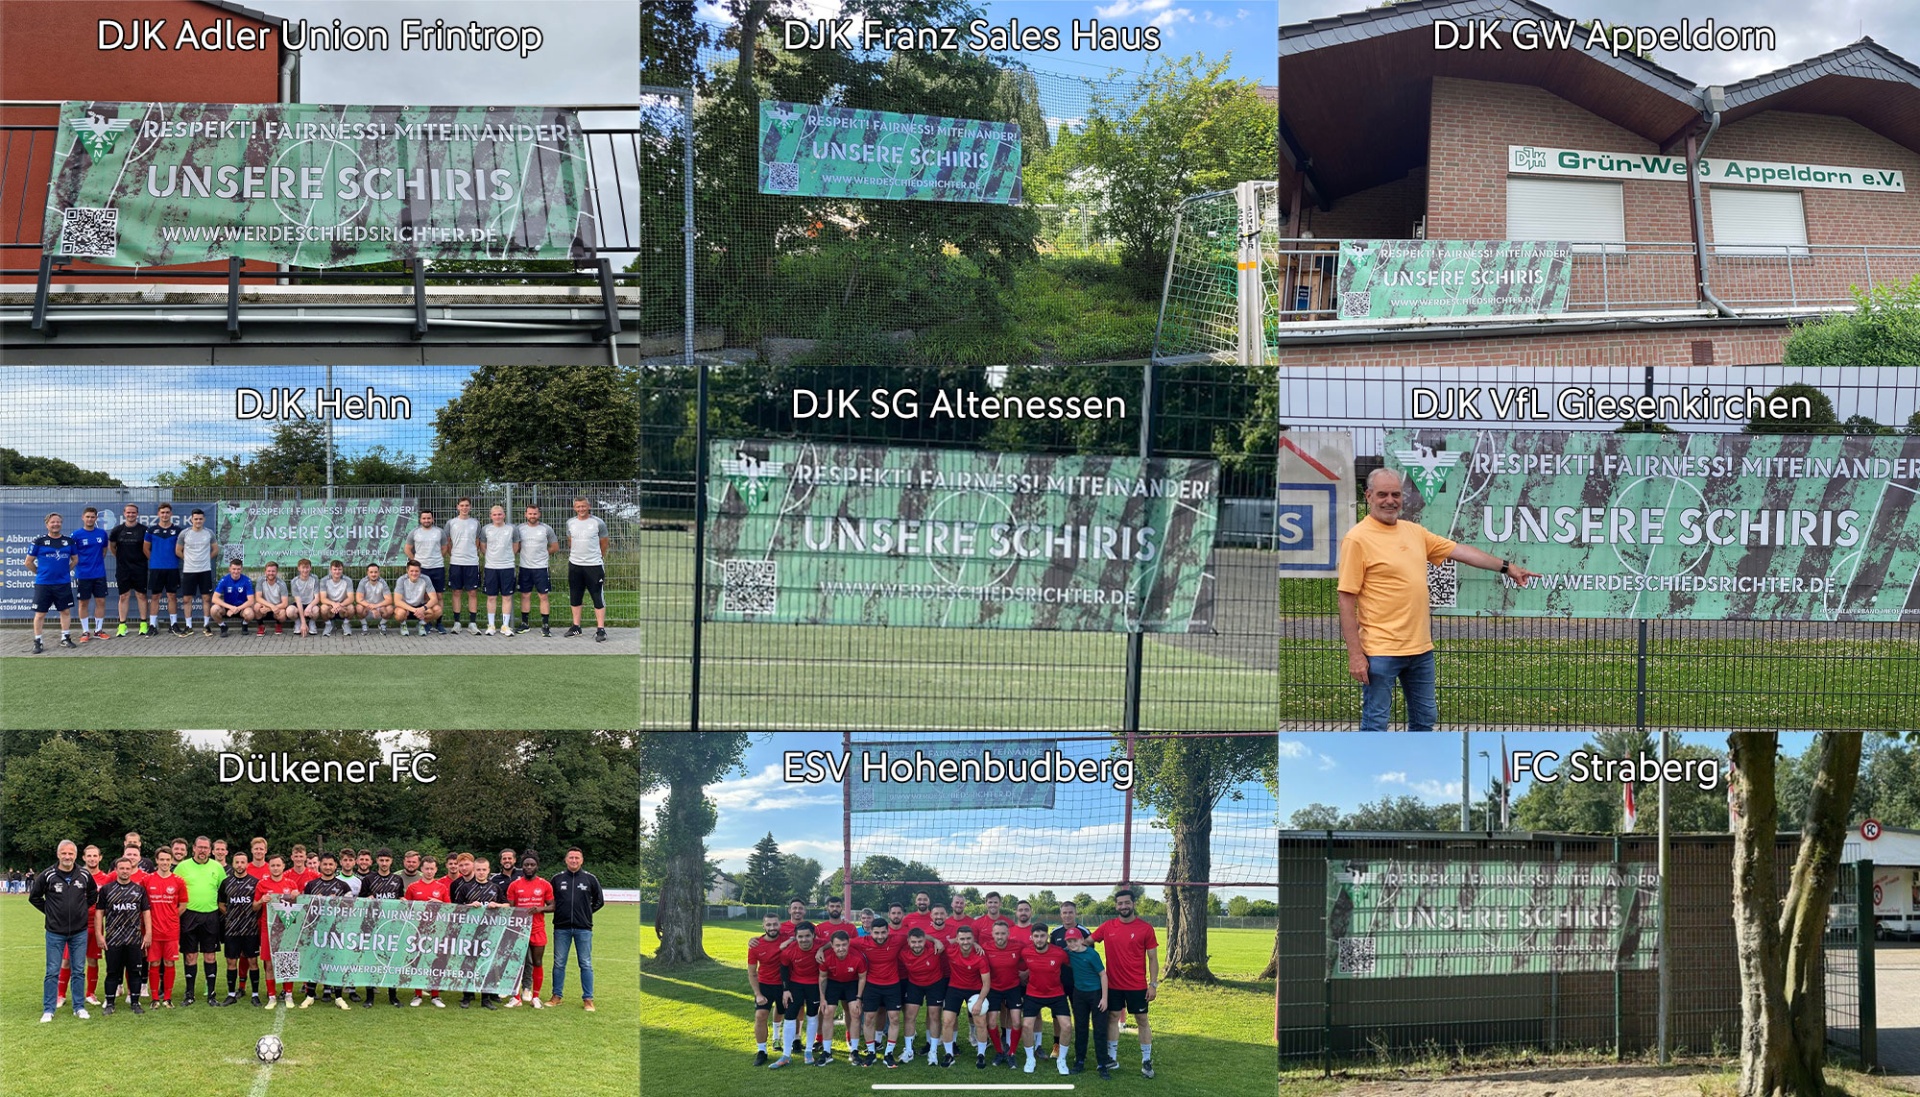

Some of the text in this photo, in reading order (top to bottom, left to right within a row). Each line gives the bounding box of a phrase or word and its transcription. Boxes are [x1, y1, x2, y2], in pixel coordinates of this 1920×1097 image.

[143, 120, 573, 142] RESPEKT! FAIRNESS! MITEINANDER!
[808, 115, 1019, 142] RESPEKT! FAIRNESS! MITEINANDER!
[812, 141, 989, 169] UNSERE SCHIRIS
[1558, 151, 1711, 176] Grün-Weß
[1724, 162, 1852, 184] Appeldorn
[1862, 171, 1901, 187] e.V.
[147, 164, 514, 201] UNSERE SCHIRIS
[822, 174, 981, 190] WWW.WERDESCHIEDSRICHTER.DE
[162, 225, 498, 243] WWW.WERDESCHIEDSRICHTER.DE
[1380, 249, 1570, 259] RESPEKT! FAIRNESS! MITEINANDER!
[1383, 269, 1544, 287] UNSERE SCHIRIS
[1474, 452, 1595, 476] RESPEKT!
[1603, 454, 1733, 478] FAIRNESS!
[799, 464, 1209, 500] RESPEKT! FAIRNESS! MITEINANDER!
[250, 505, 416, 516] RESPEKT! FAIRNESS! MITEINANDER!
[252, 525, 390, 540] UNSERE SCHIRIS
[1482, 504, 1860, 547] UNSERE SCHIRIS
[804, 516, 1156, 562] UNSERE SCHIRIS
[820, 580, 1136, 605] WWW.WERDESCHIEDSRICHTER.DE
[113, 902, 137, 911] MARS
[230, 896, 251, 904] MARS
[310, 905, 529, 927] RESPEKT! FAIRNESS! MITEINANDER!
[1393, 904, 1622, 930] UNSERE SCHIRIS
[313, 930, 492, 957] UNSERE SCHIRIS
[321, 963, 480, 979] WWW.WERDESCHIEDSRICHTER.DE
